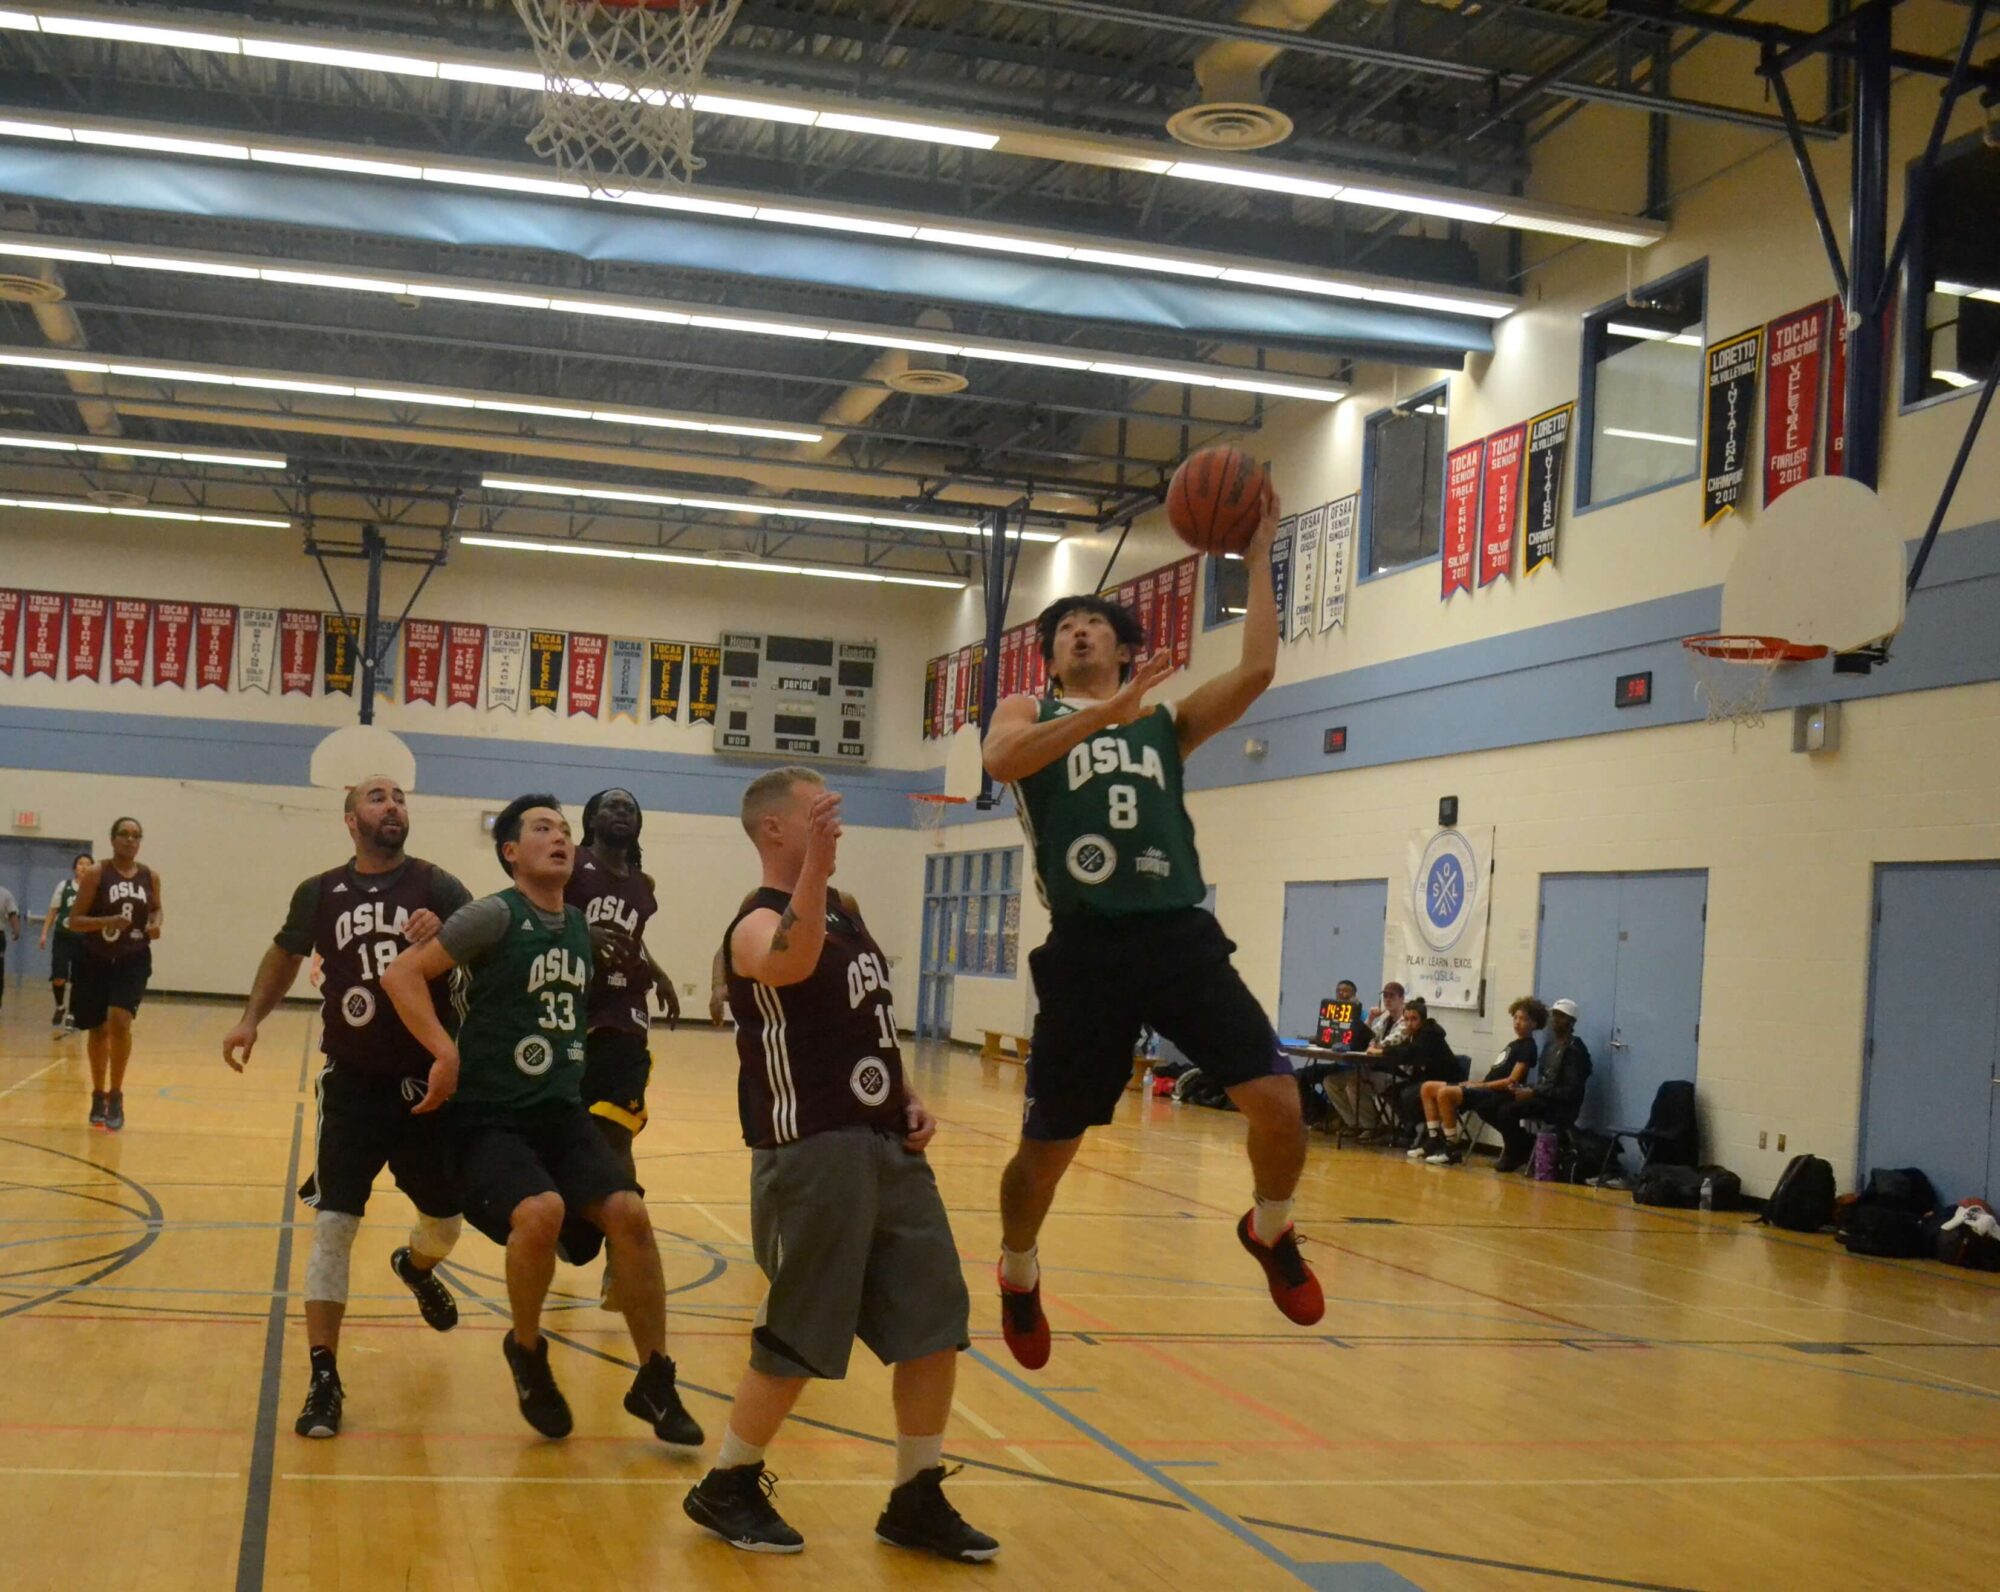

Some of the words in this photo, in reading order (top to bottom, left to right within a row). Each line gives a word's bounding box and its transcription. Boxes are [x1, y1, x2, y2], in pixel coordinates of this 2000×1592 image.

[1776, 315, 1818, 349] TDCAA
[1713, 338, 1757, 372] LORETTO
[1532, 411, 1568, 439] LORETTO
[1491, 450, 1517, 470] SENIOR
[1779, 465, 1802, 485] 2012
[1451, 467, 1475, 485] SENIOR
[1452, 481, 1474, 499] TABLE
[1498, 474, 1508, 533] TENNIS
[1715, 486, 1737, 504] 2011
[1458, 496, 1467, 553] TENNIS
[1334, 541, 1343, 593] TENNIS
[783, 679, 813, 690] period
[1067, 735, 1166, 791] QSLA
[1108, 783, 1138, 829] 8
[109, 881, 147, 904] QSLA
[527, 947, 586, 994] QSLA
[538, 991, 576, 1030] 33
[1326, 1003, 1352, 1022] 14:33
